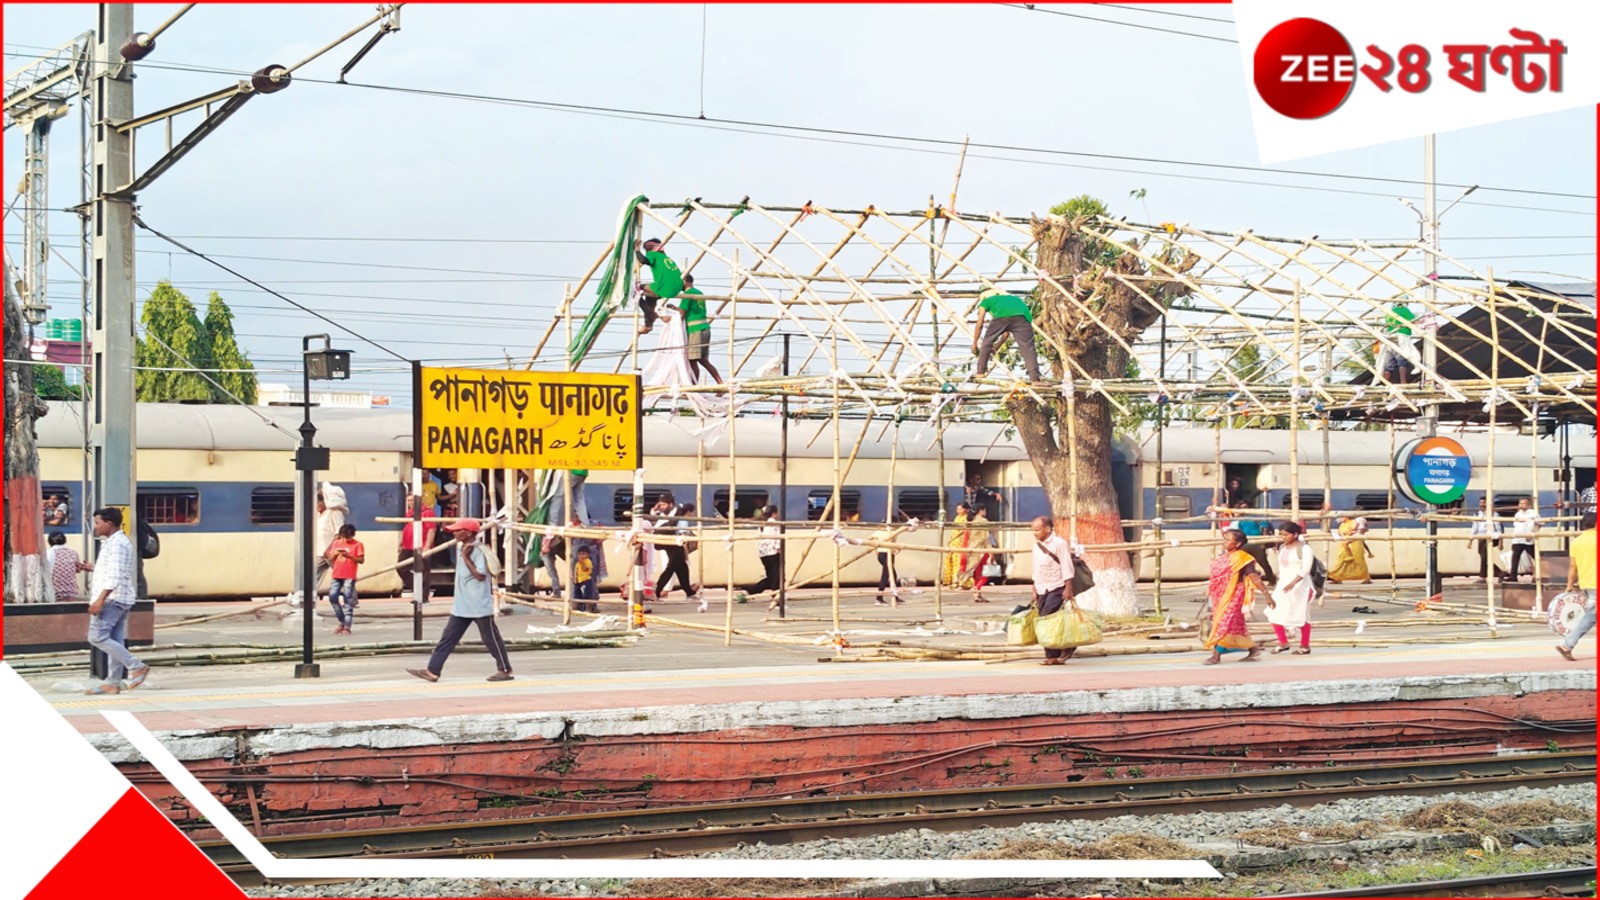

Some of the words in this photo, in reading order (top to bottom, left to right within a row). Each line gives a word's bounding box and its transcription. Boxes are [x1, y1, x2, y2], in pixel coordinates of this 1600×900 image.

[429, 374, 532, 420] পানাগড়
[538, 382, 630, 424] पानागढ़
[427, 426, 544, 455] PANAGARH
